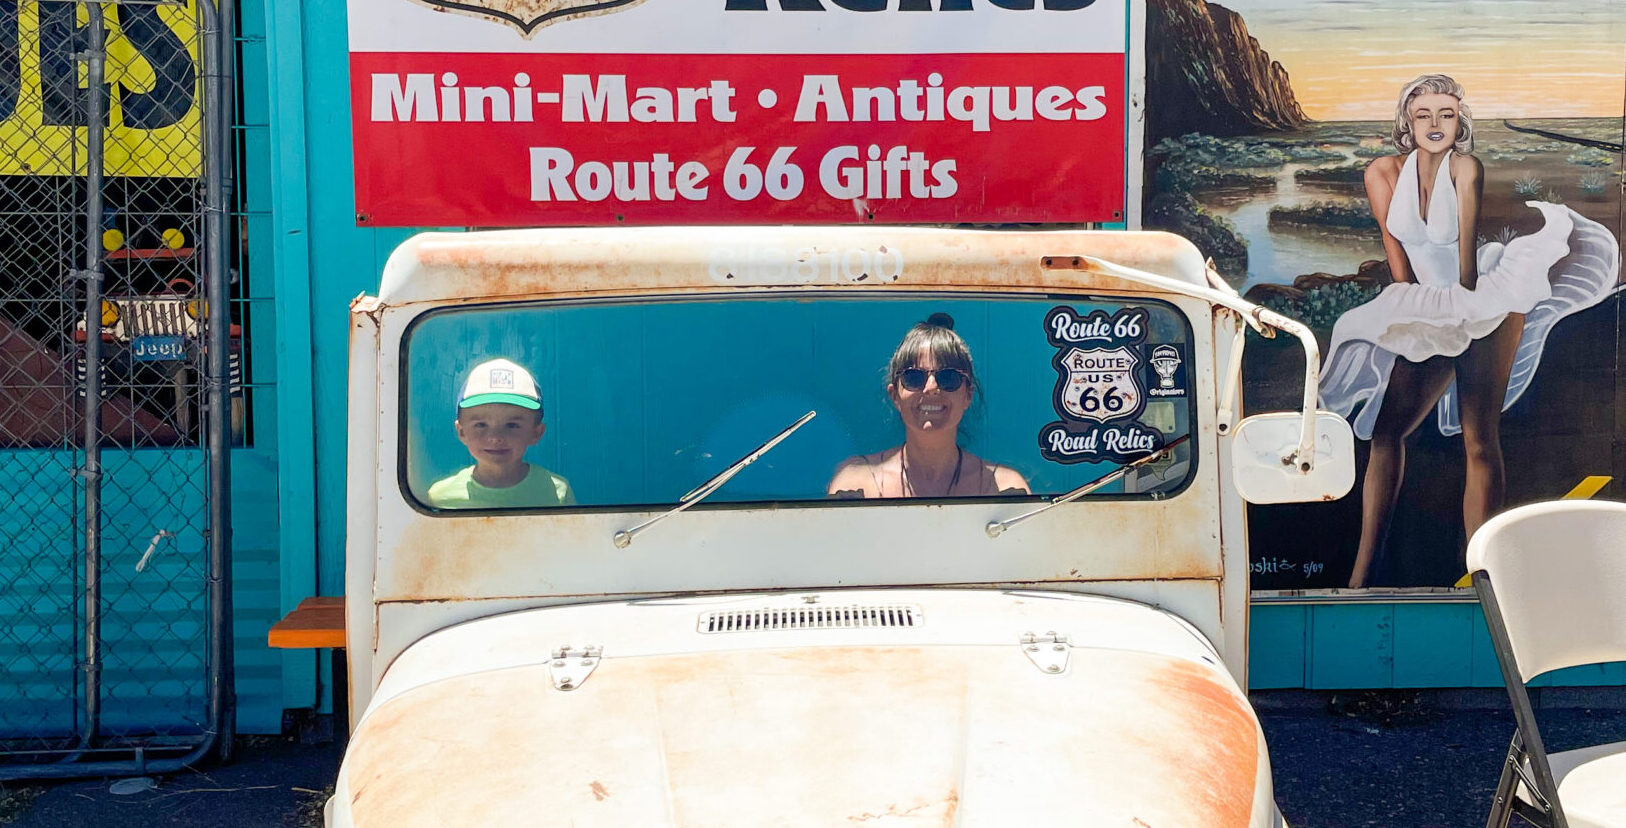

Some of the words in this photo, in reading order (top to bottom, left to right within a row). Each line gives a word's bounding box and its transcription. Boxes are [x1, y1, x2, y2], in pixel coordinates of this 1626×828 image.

[371, 72, 737, 123] Mini-Mart
[793, 72, 1107, 132] Antiques
[529, 146, 710, 202] Route
[723, 146, 805, 201] 66
[819, 143, 958, 201] Gifts
[1052, 312, 1112, 342] Route
[1114, 314, 1141, 337] 66
[1074, 358, 1125, 369] ROUTE
[1088, 374, 1114, 383] US
[1080, 386, 1123, 412] 66
[1049, 429, 1098, 454] Road
[1103, 428, 1155, 454] Relics
